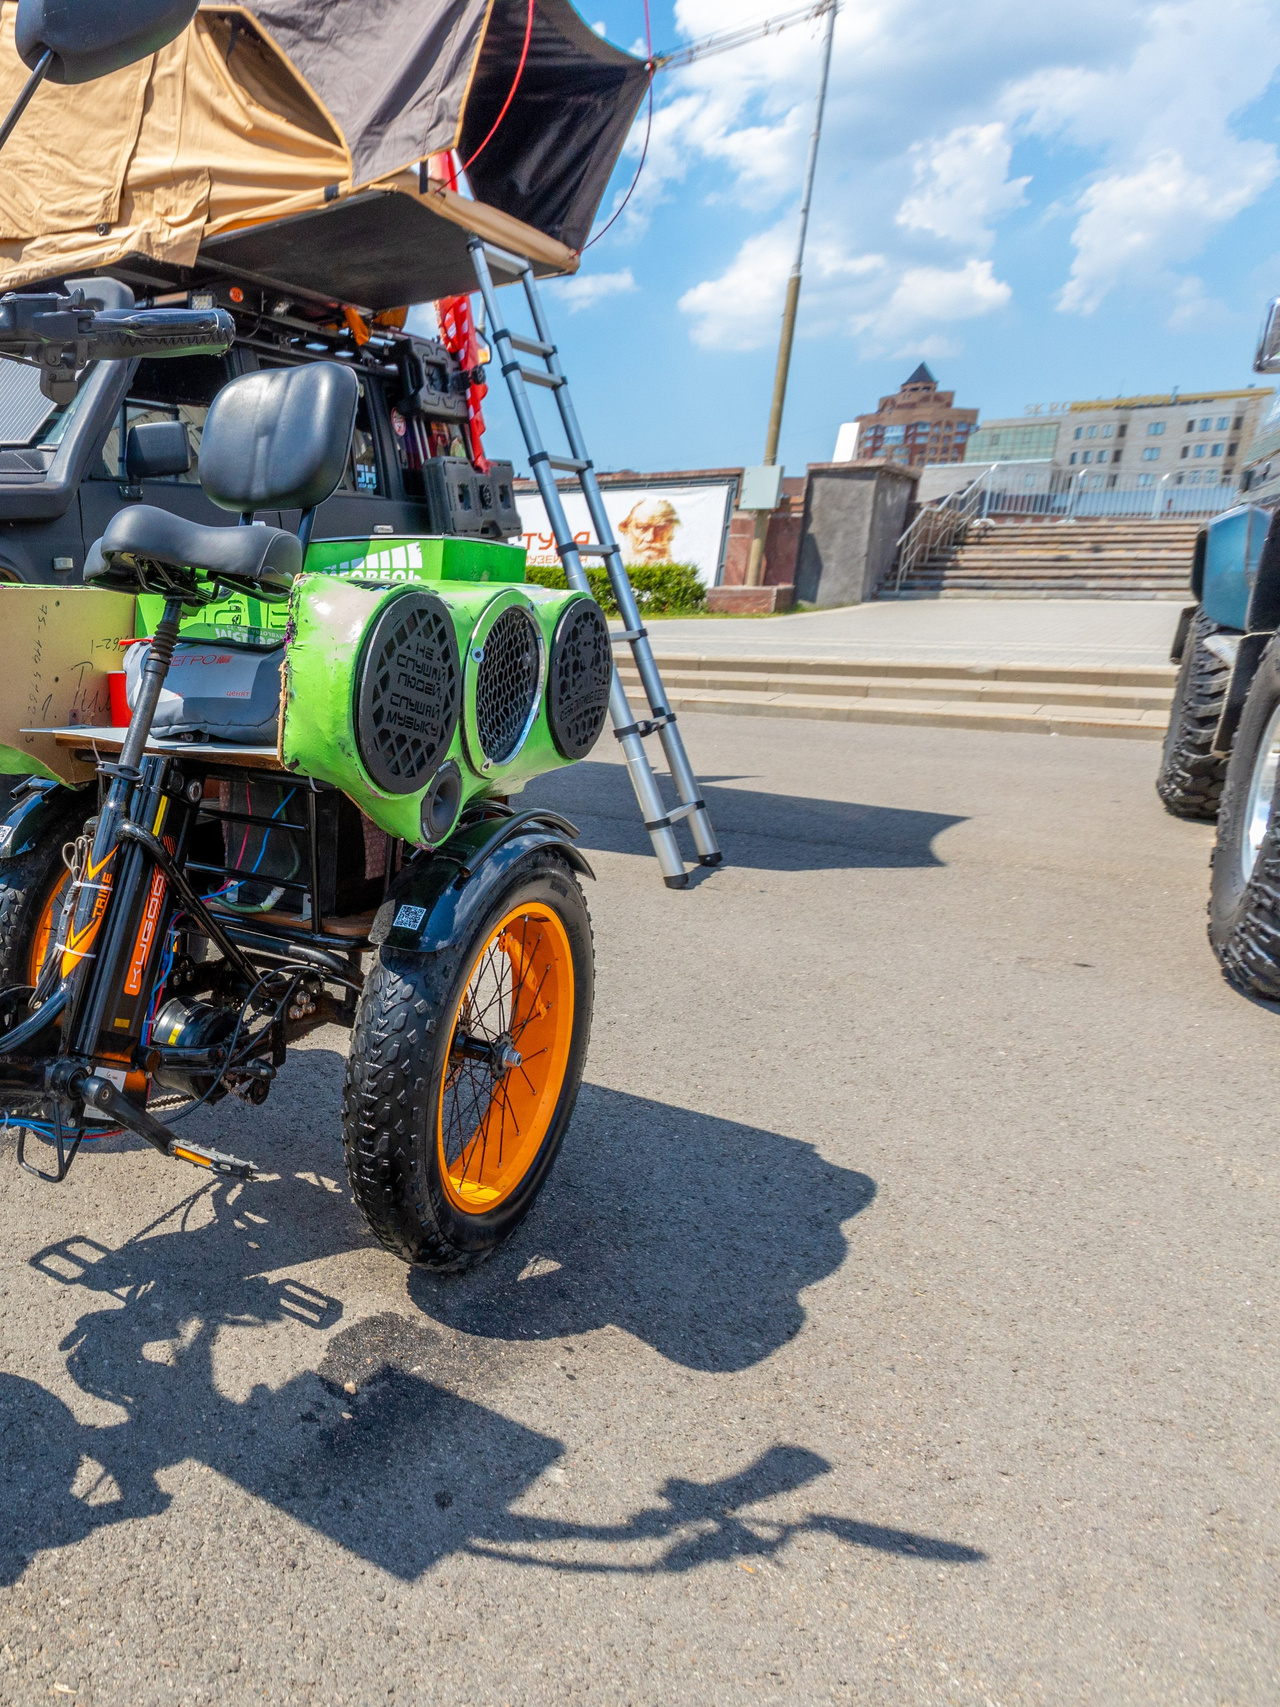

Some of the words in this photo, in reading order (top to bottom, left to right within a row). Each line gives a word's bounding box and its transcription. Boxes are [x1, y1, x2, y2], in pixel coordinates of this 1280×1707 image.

[522, 531, 590, 551] ТУА
[170, 654, 217, 667] ЕГРО
[415, 642, 435, 660] НЕ
[396, 653, 447, 683] СЛУШАЙ
[226, 690, 250, 698] ценят
[390, 692, 440, 720] СЛУШАЙ
[386, 710, 439, 737] МУЗЫКУ
[91, 872, 113, 919] TRIKE
[129, 874, 165, 989] KUGOO
